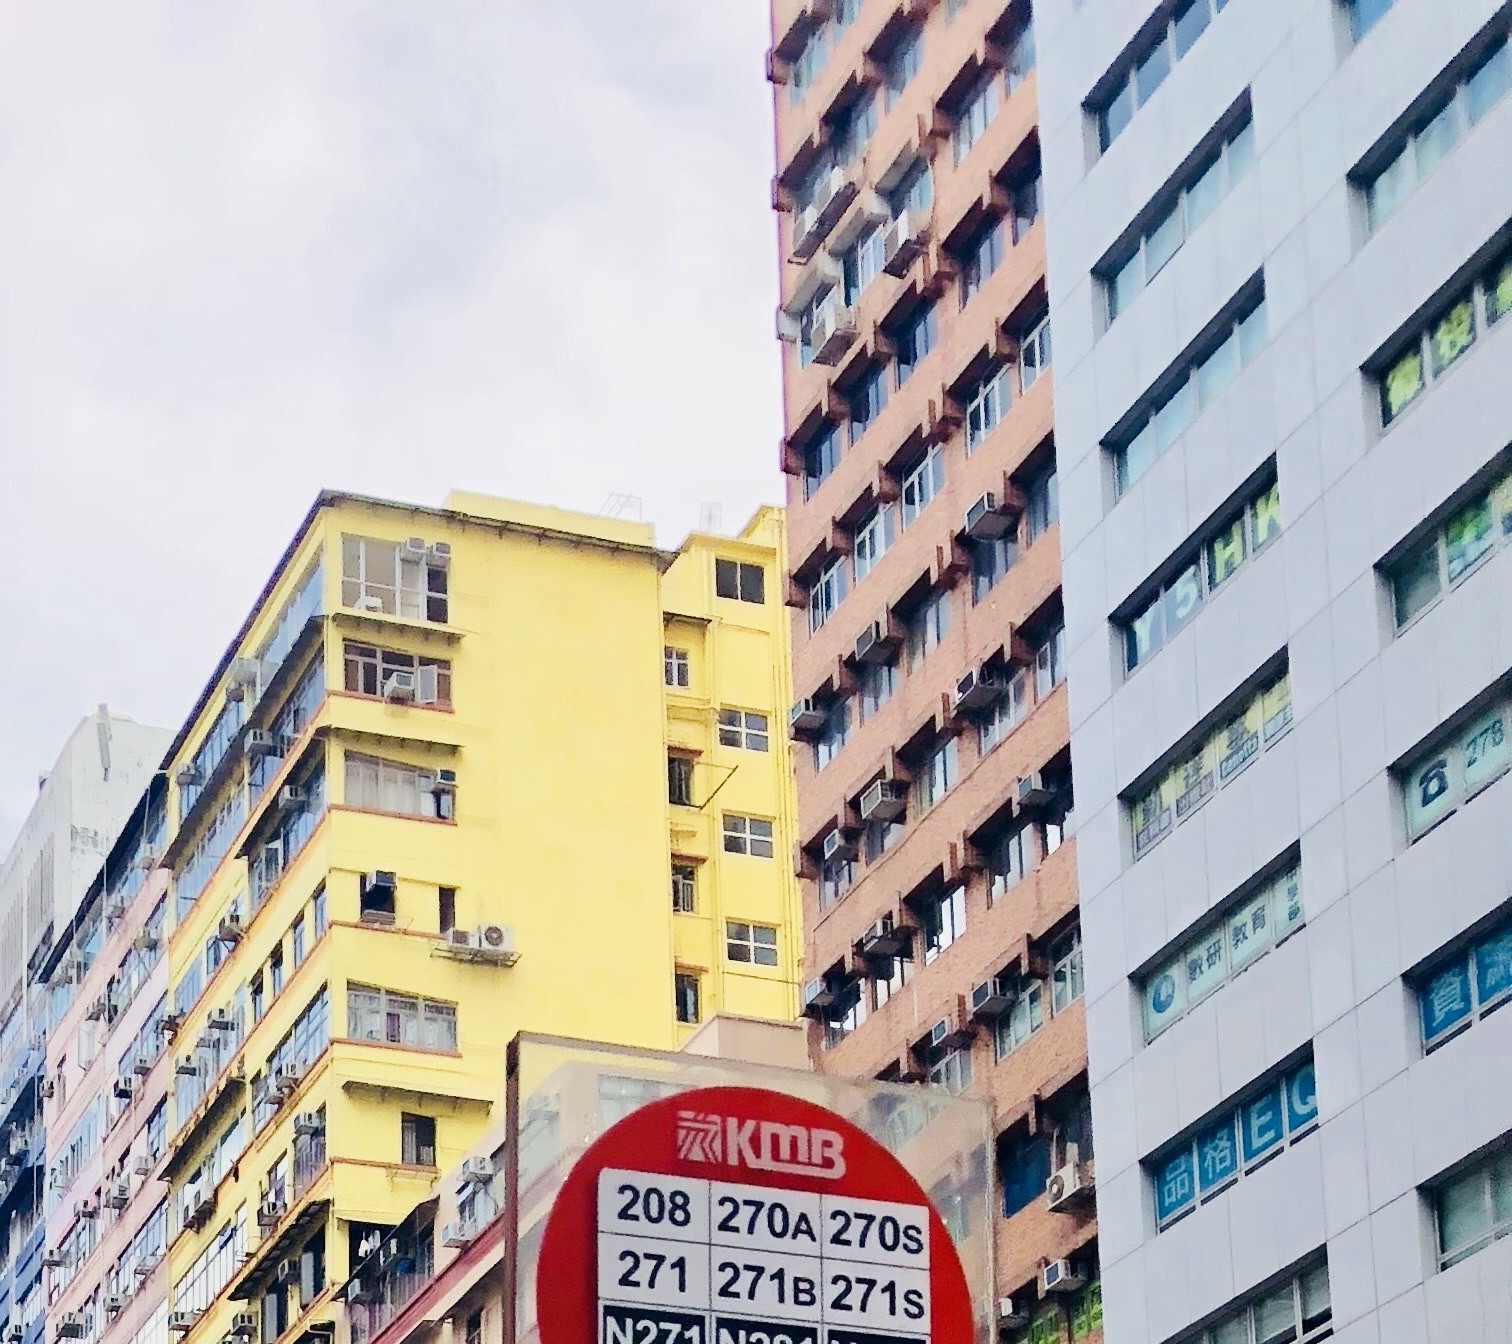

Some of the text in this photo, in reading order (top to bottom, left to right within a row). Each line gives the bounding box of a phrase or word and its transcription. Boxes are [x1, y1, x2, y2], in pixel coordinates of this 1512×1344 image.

[725, 1118, 846, 1179] KMB
[617, 1184, 924, 1255] 208 270A 270S
[617, 1250, 925, 1319] 271 271B 271S
